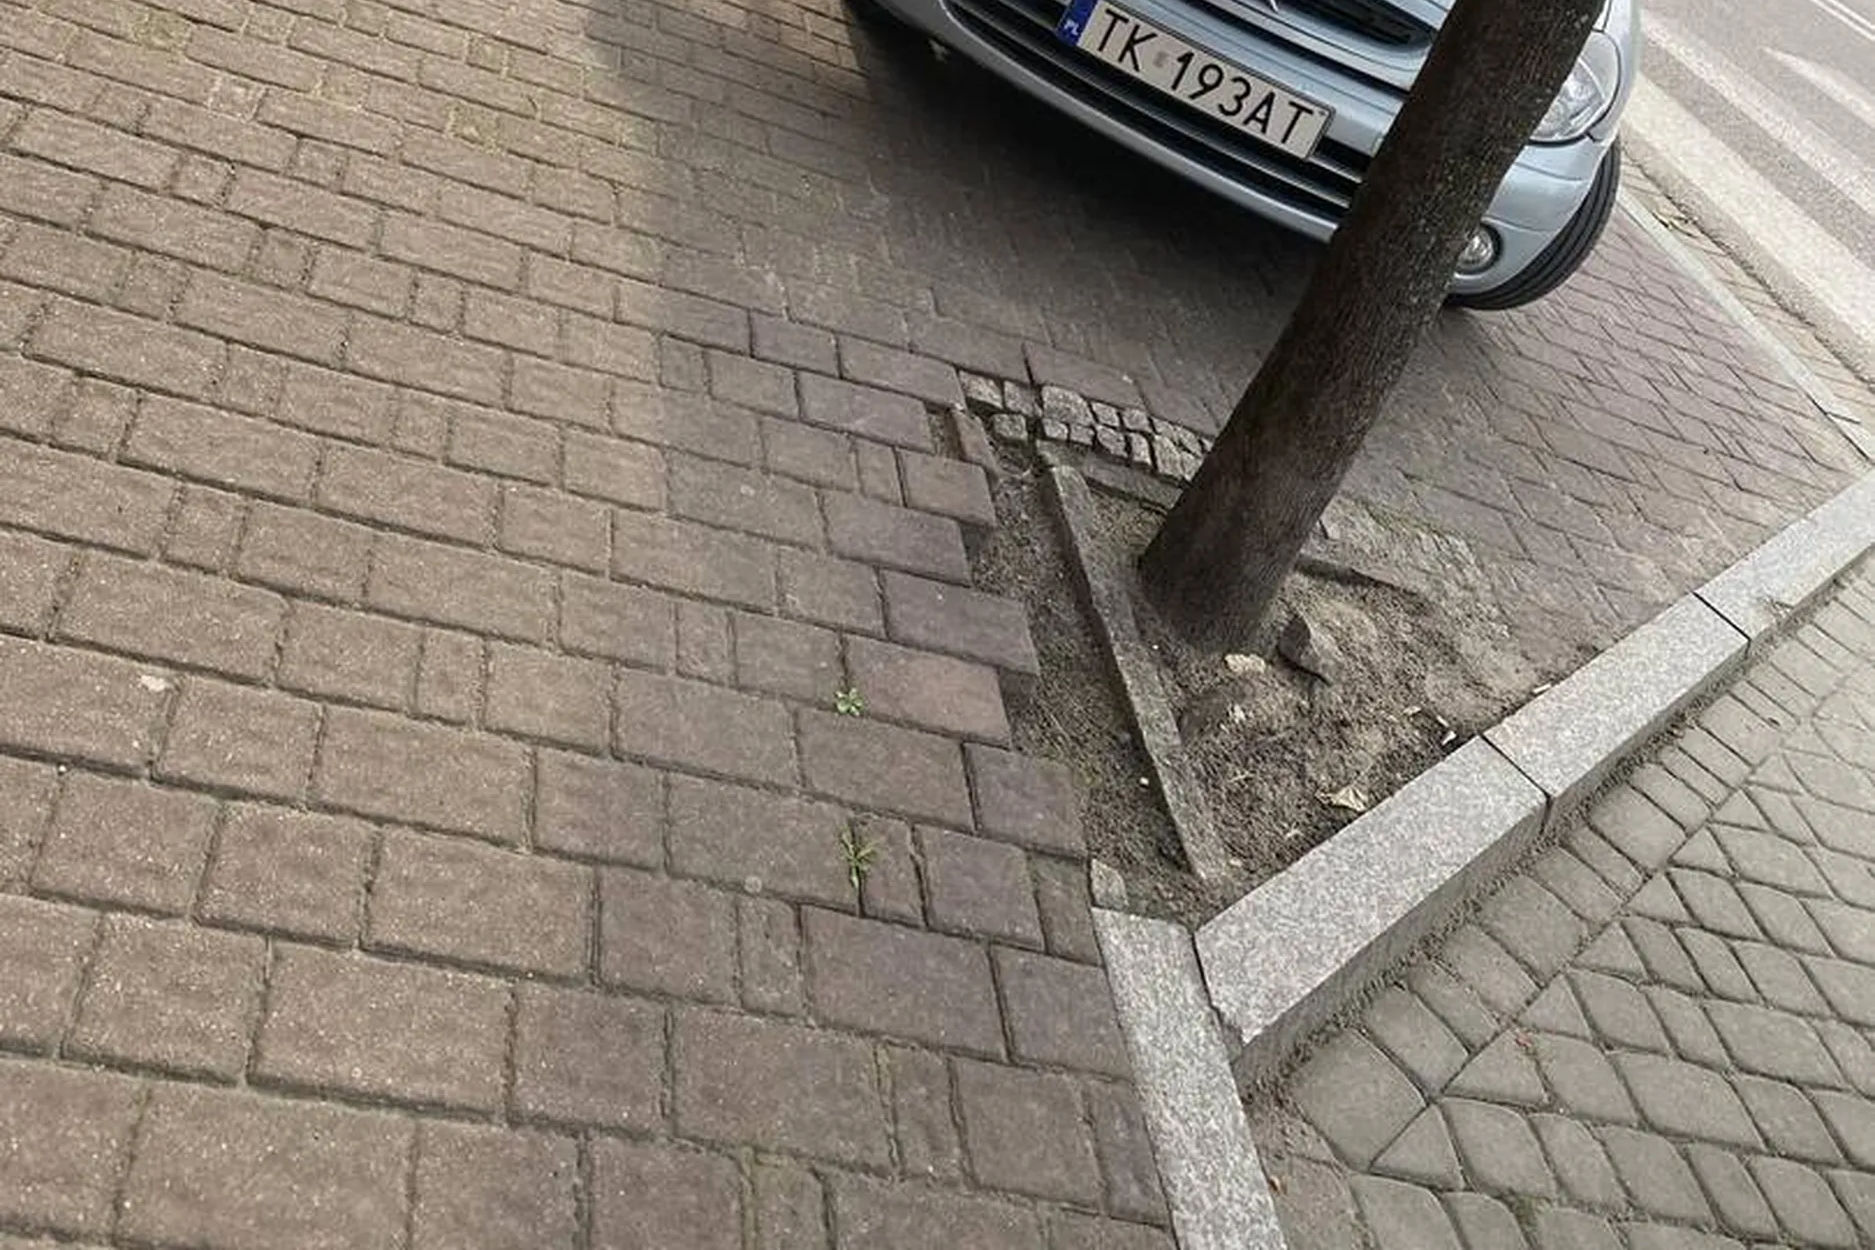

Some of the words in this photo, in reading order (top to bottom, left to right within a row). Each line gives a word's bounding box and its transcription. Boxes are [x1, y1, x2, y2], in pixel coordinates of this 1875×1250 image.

[1062, 18, 1080, 37] PL
[1096, 7, 1157, 73] TK
[1170, 50, 1315, 146] 193AT
